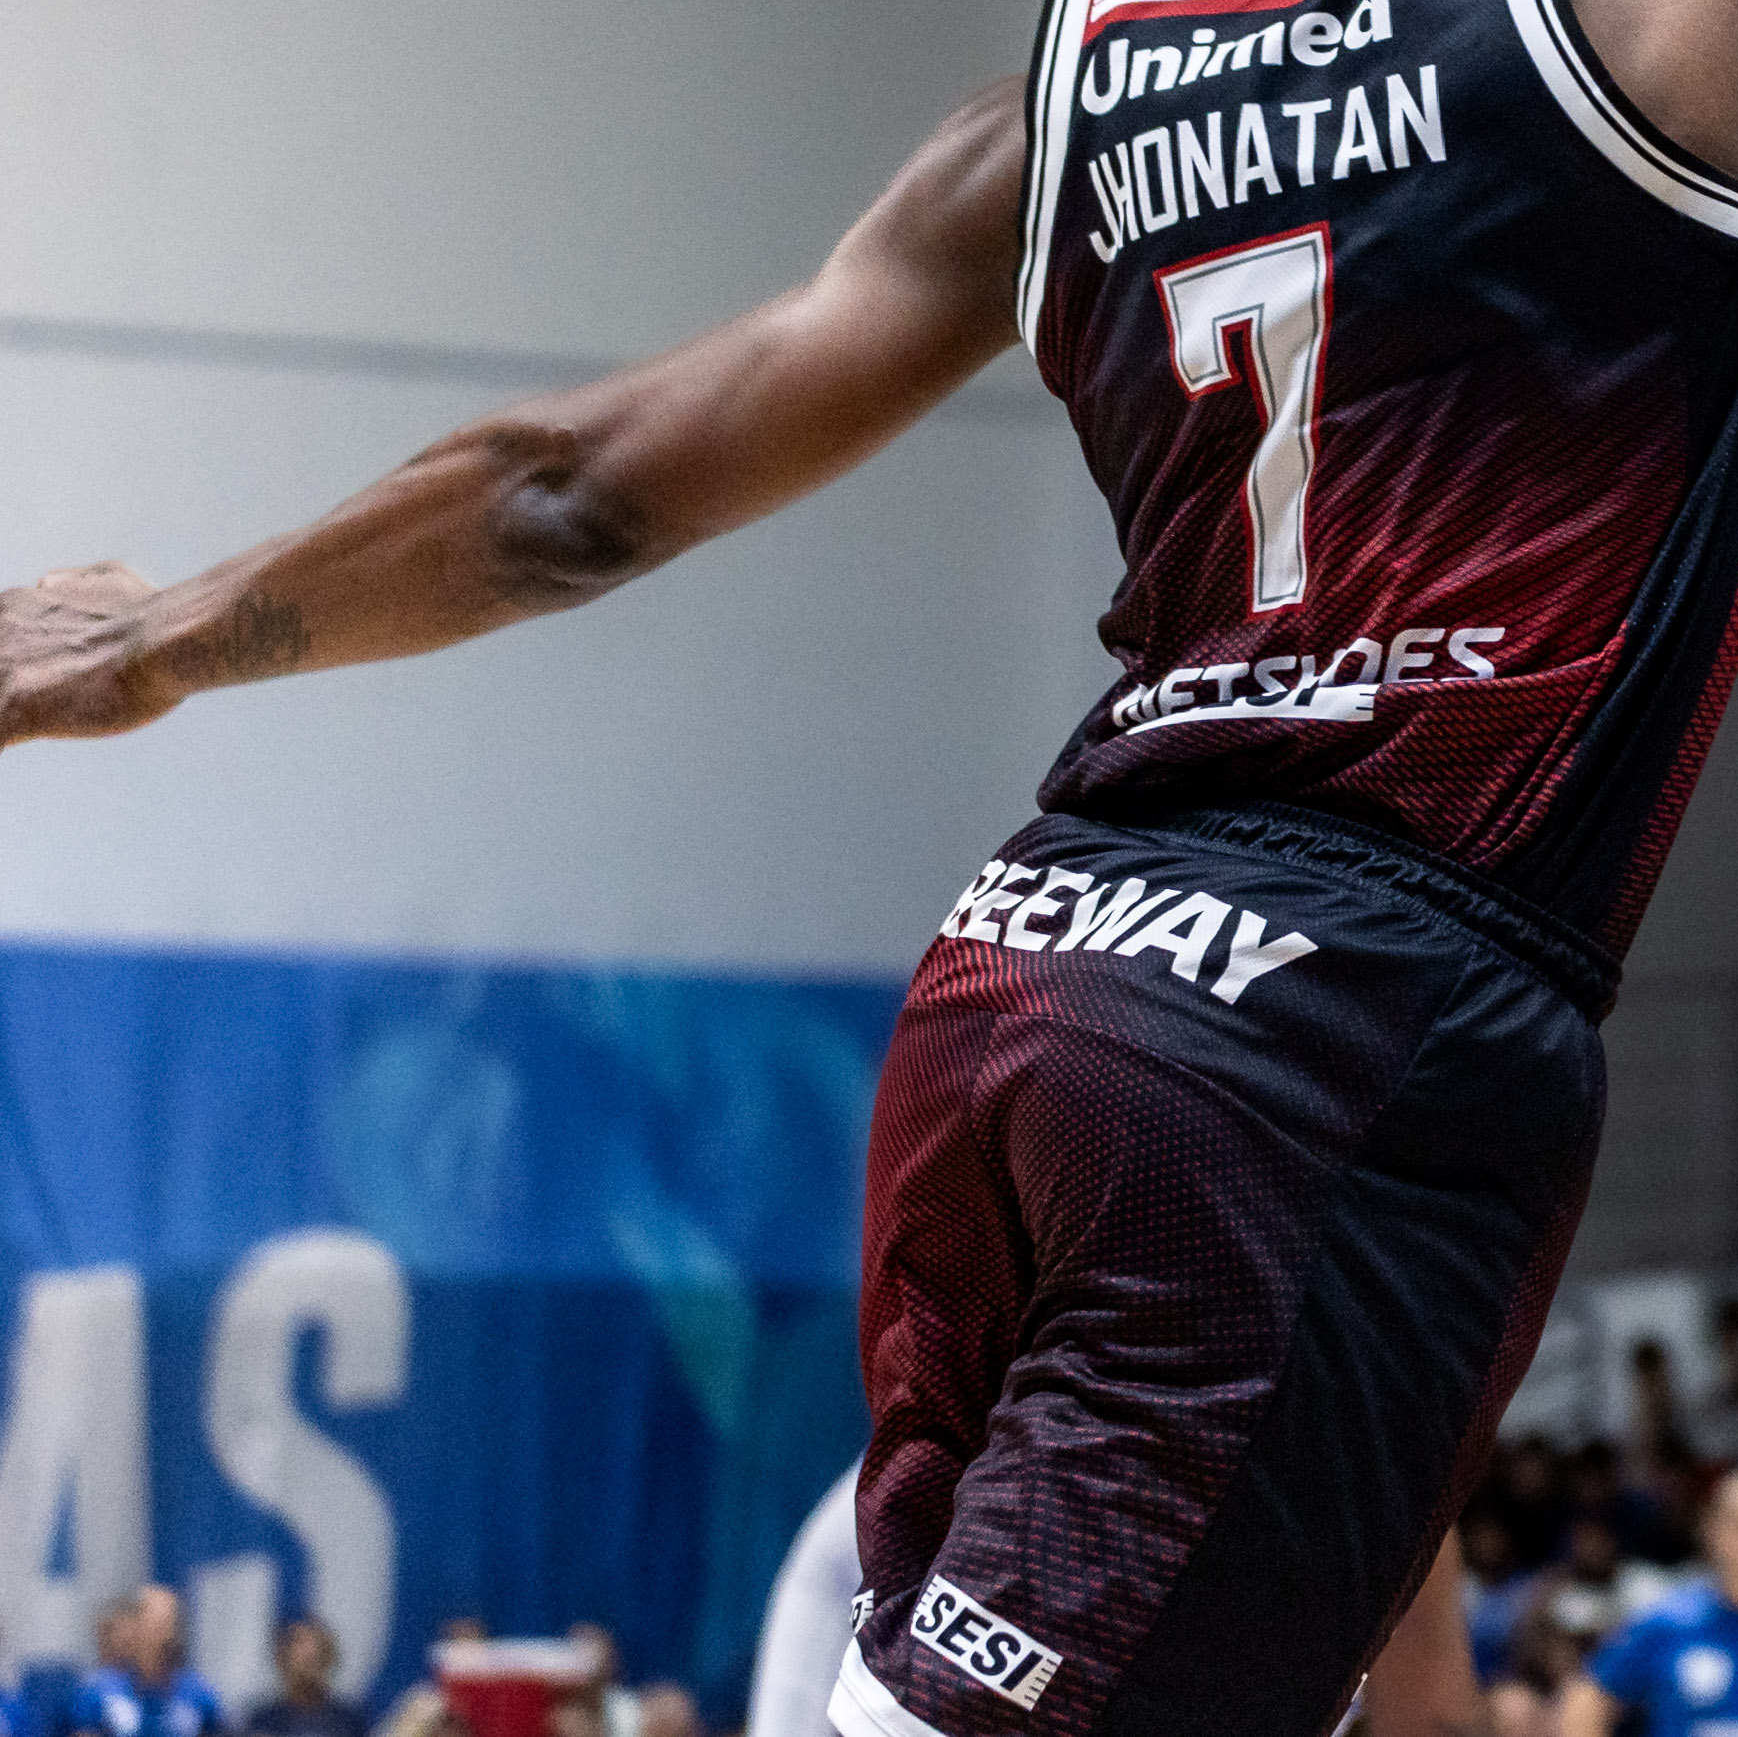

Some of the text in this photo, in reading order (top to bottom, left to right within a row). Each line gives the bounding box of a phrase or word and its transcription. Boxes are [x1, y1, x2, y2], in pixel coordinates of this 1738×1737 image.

[1088, 64, 1448, 264] JHONATAN
[1152, 220, 1335, 622] 7
[915, 1591, 1045, 1693] SESI
